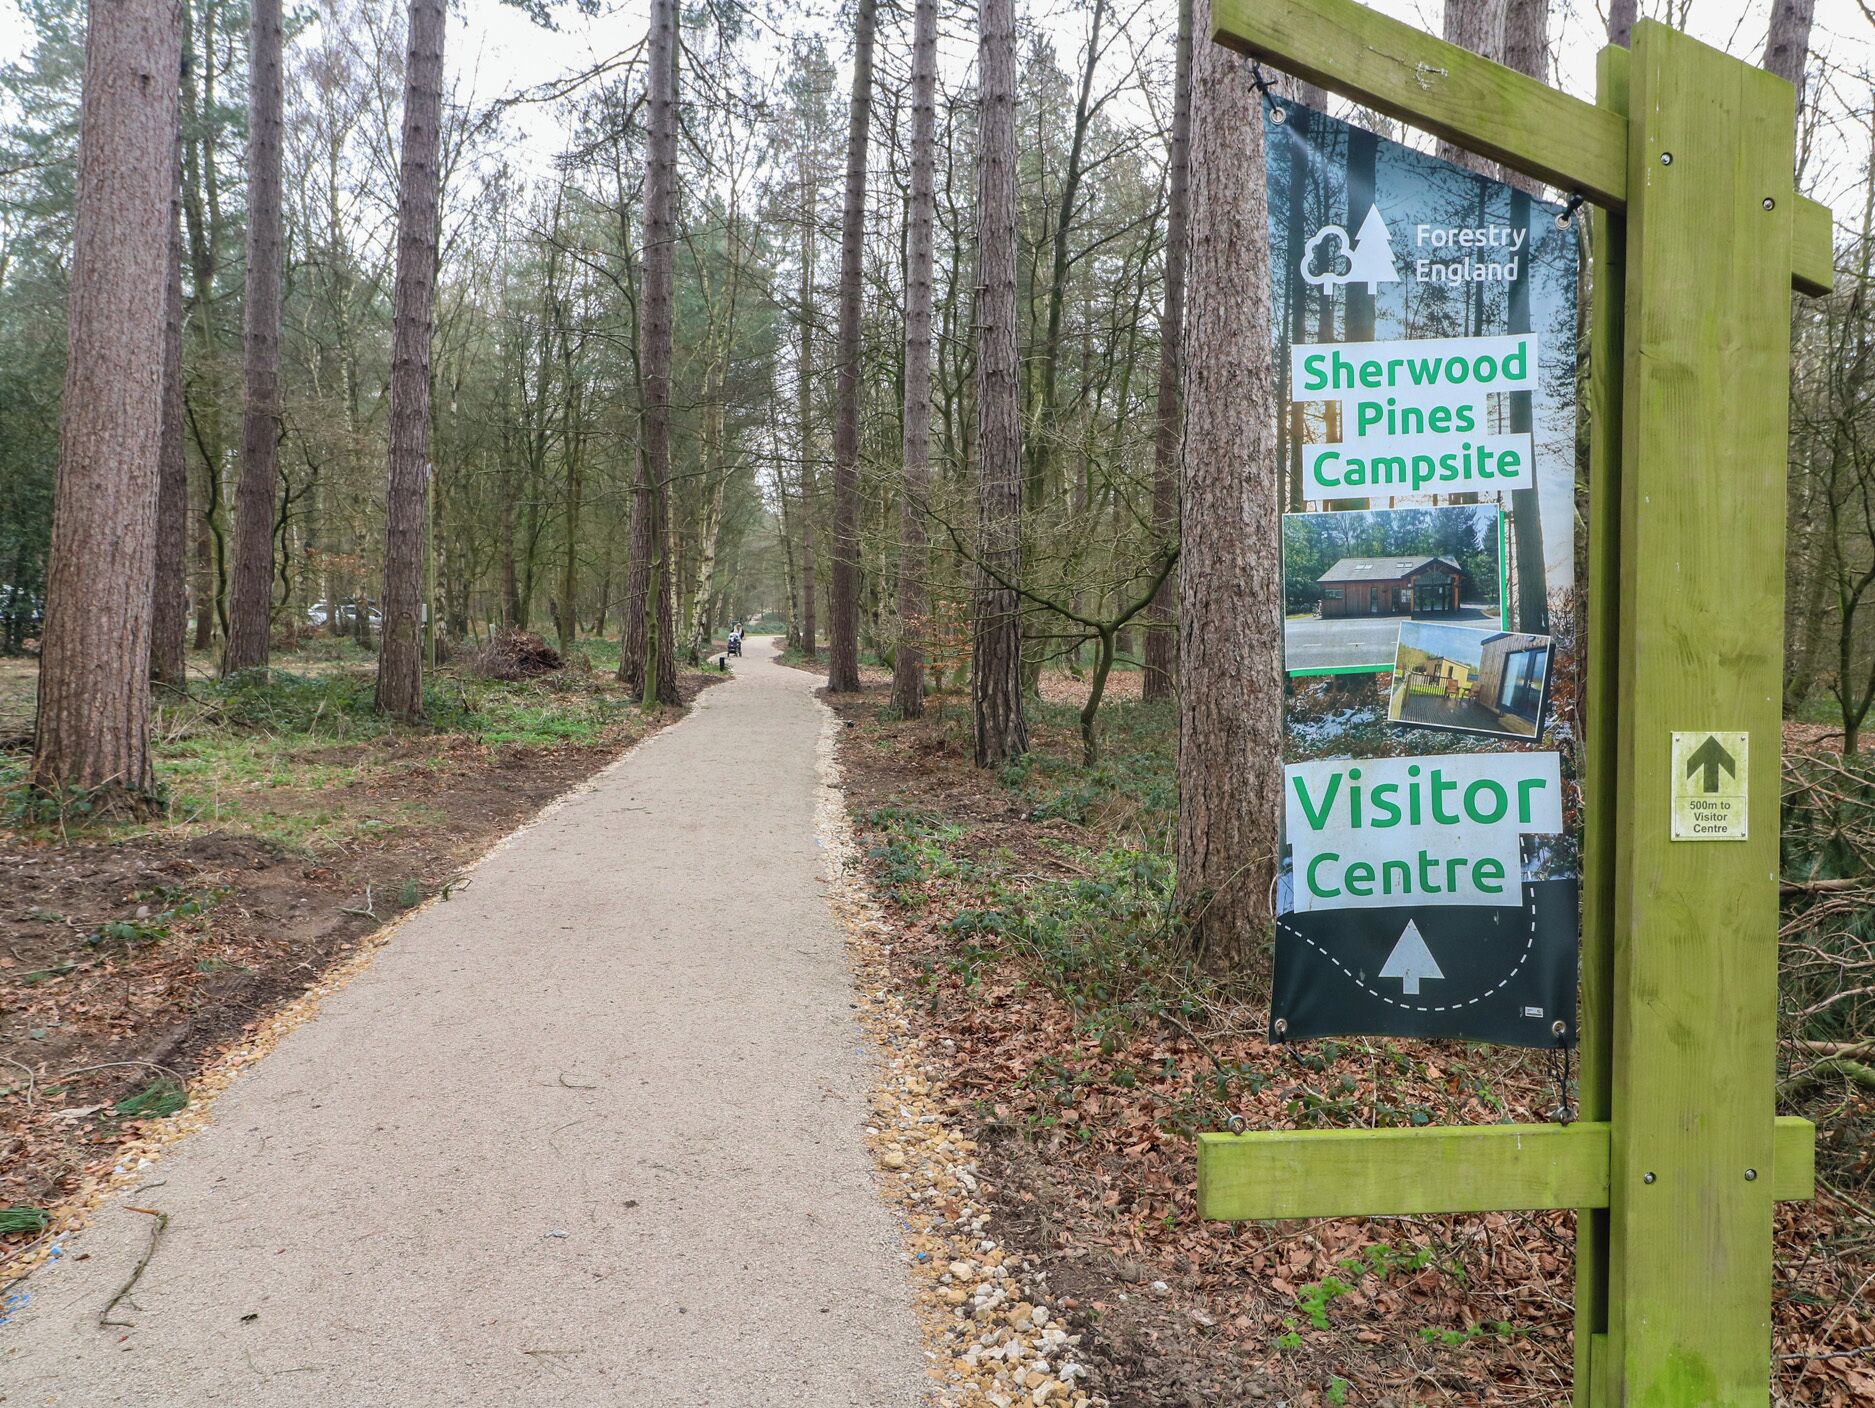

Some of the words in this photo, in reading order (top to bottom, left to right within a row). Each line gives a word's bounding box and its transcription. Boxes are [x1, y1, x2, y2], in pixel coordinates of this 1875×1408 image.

[1416, 223, 1527, 250] Forestry
[1416, 256, 1519, 286] England
[1303, 341, 1528, 390] Sherwood
[1357, 397, 1476, 436] Pines
[1313, 443, 1522, 490] Campsite
[1292, 765, 1547, 830] Visitor
[1689, 800, 1717, 810] 500m
[1720, 800, 1731, 810] to
[1693, 823, 1728, 833] Centre
[1694, 812, 1728, 822] Visitor
[1306, 849, 1506, 898] Centre
